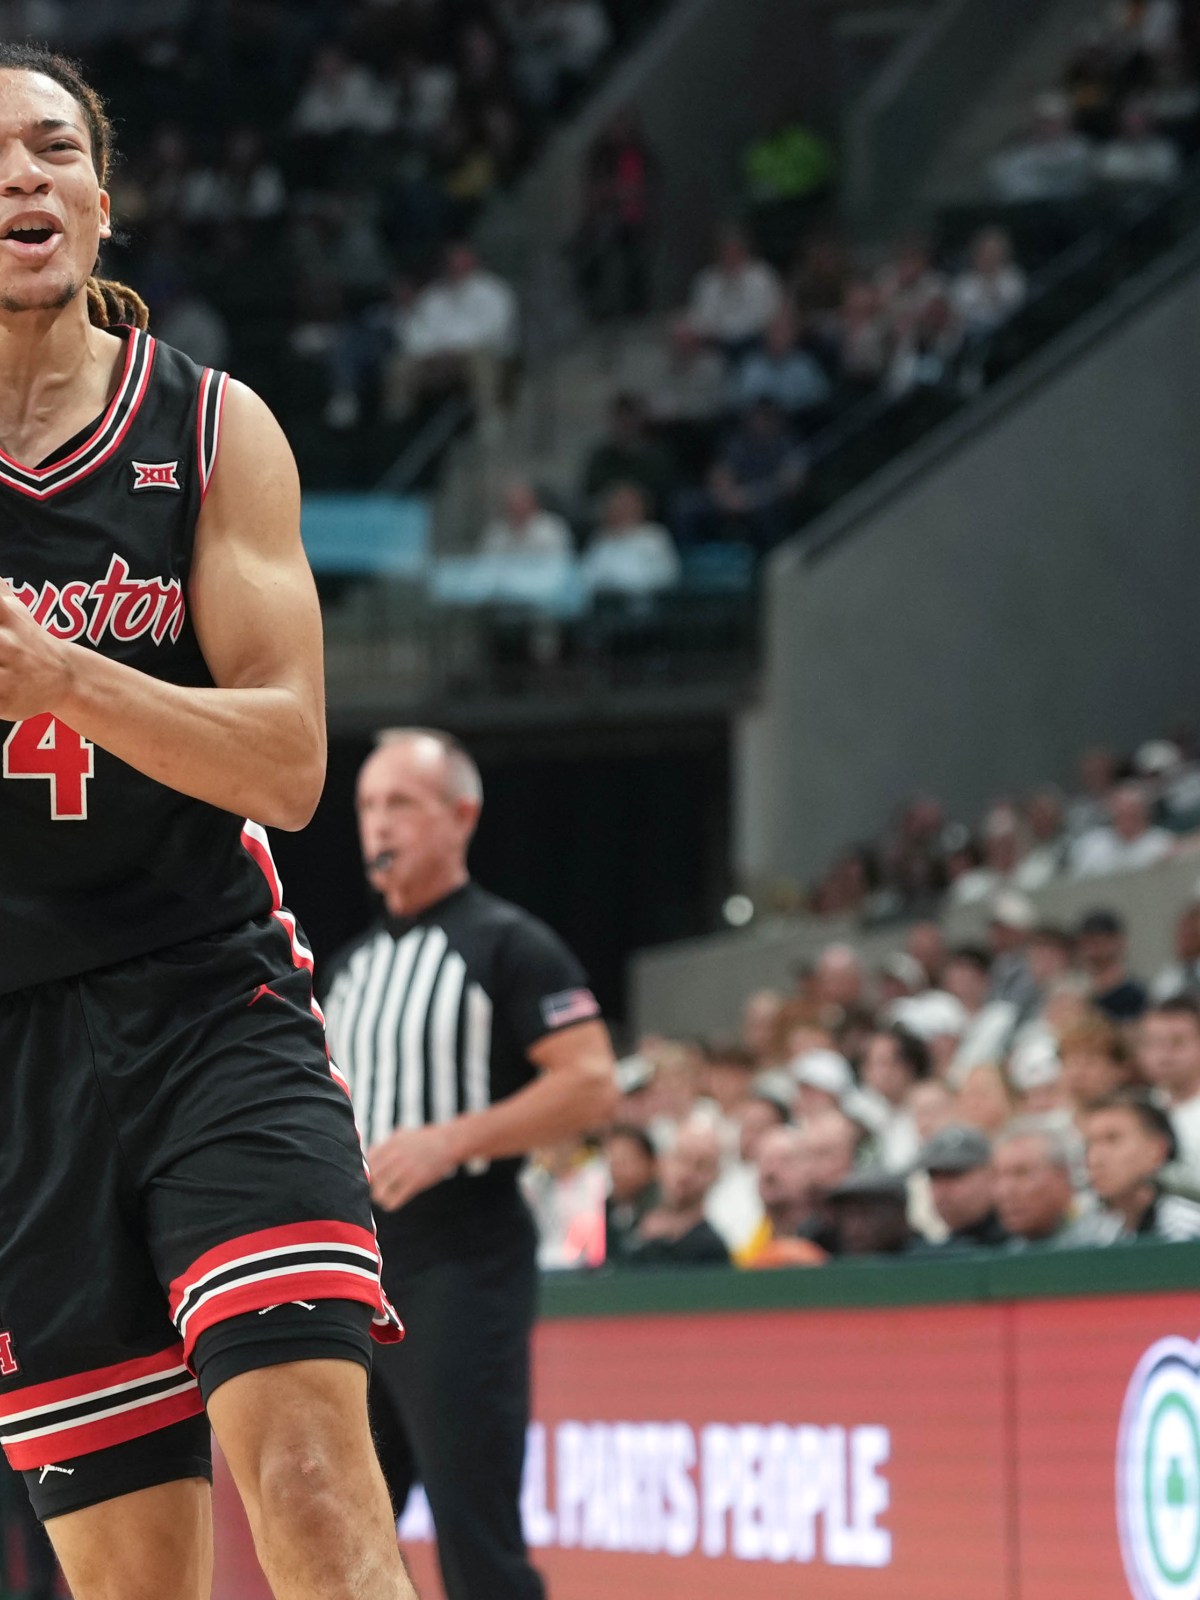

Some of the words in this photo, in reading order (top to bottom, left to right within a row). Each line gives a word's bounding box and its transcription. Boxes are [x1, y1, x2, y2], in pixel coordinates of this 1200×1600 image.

[133, 462, 179, 488] XII
[3, 712, 94, 820] 4
[556, 1419, 698, 1556] PARTS
[701, 1421, 891, 1568] PEOPLE
